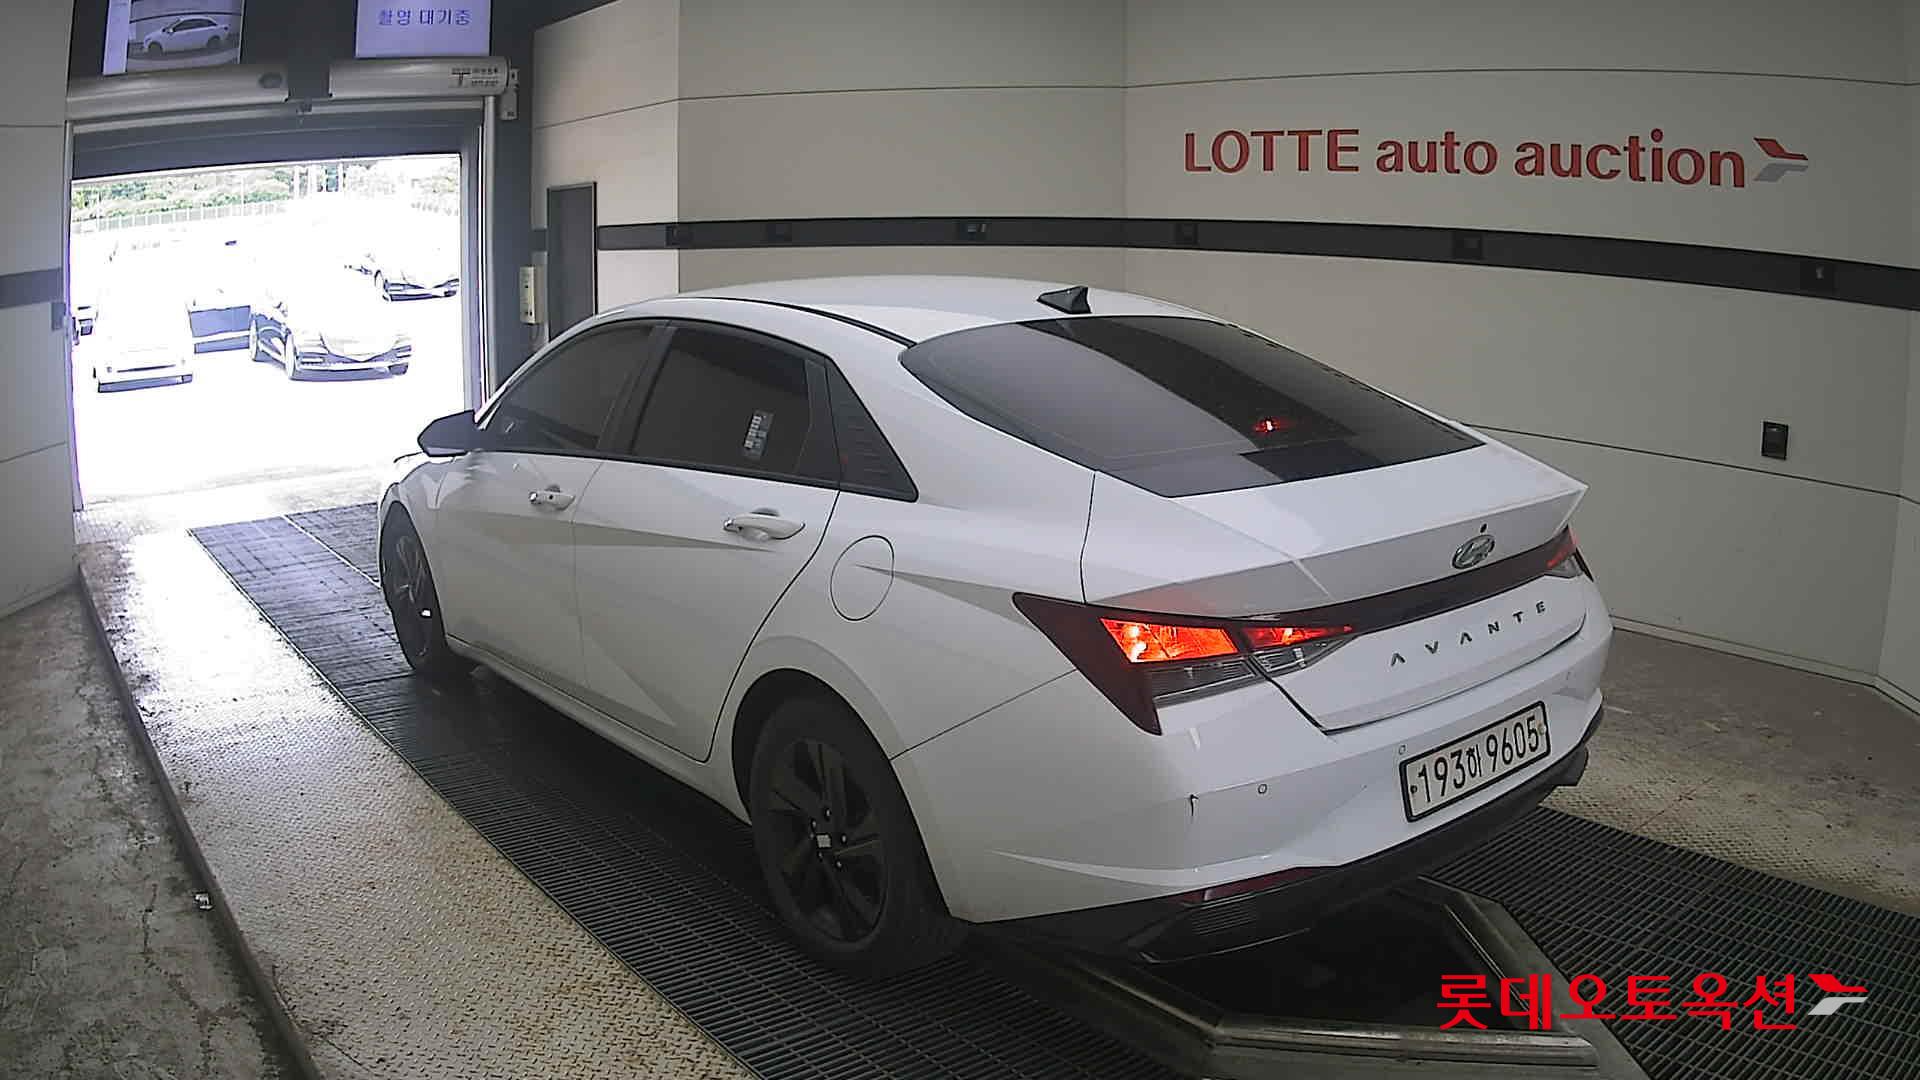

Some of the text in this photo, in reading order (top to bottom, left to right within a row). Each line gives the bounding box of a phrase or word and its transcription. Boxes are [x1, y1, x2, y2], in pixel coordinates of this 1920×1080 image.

[419, 9, 470, 26] 대기중
[1184, 128, 1745, 188] LOTTE auto auction
[1390, 601, 1547, 667] AVANTE
